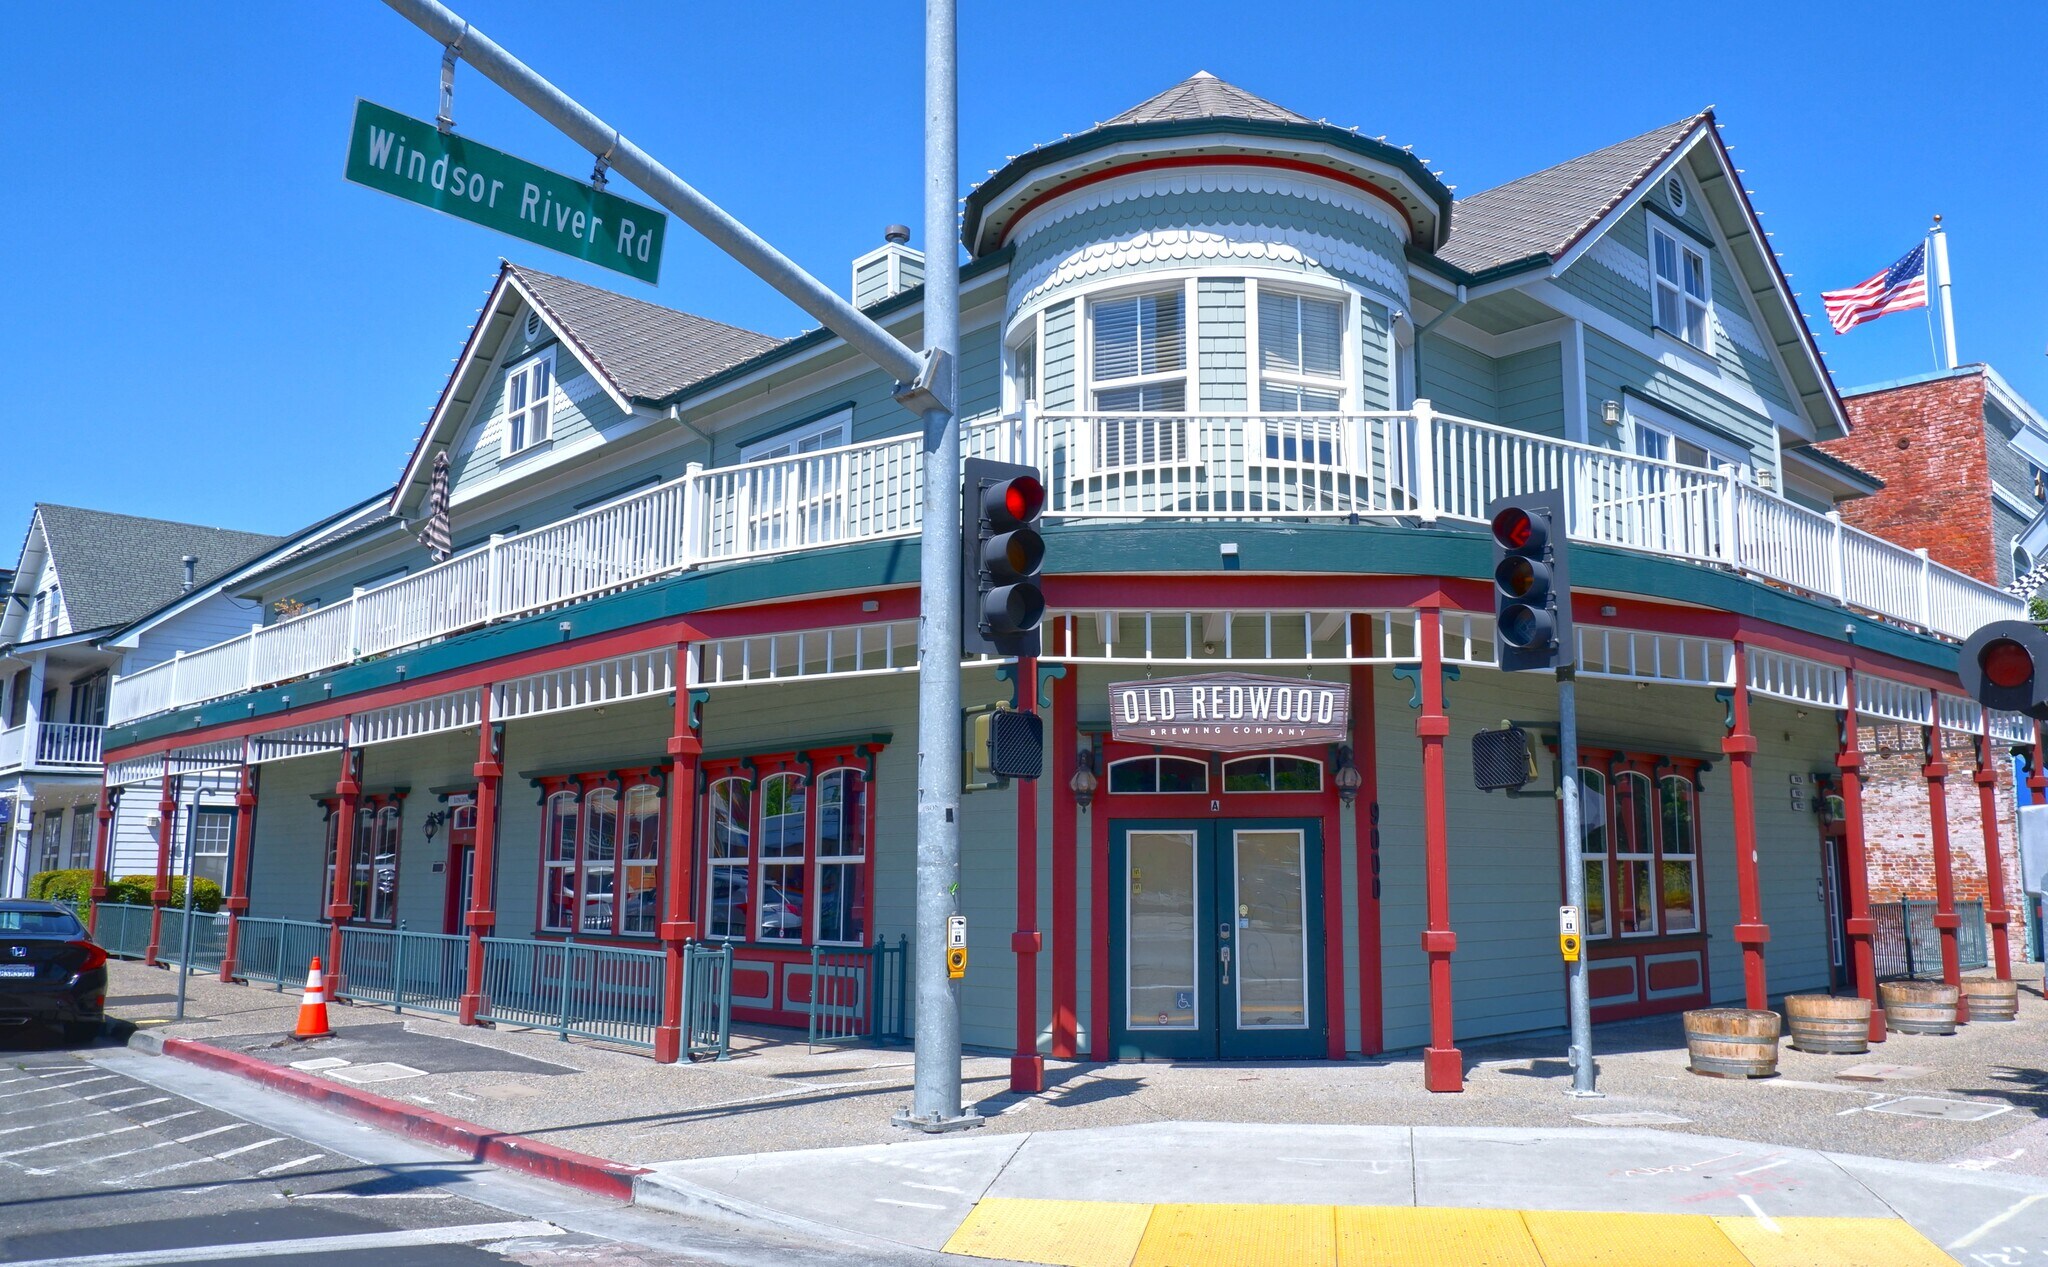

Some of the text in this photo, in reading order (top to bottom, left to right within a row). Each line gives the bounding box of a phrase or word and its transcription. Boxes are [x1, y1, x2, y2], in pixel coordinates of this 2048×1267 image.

[368, 125, 653, 263] Windsor River Rd
[1122, 686, 1334, 725] OLD REDWOOD
[1150, 726, 1307, 736] BREWING COMPANY
[1211, 800, 1219, 811] A
[1370, 802, 1381, 900] 9000
